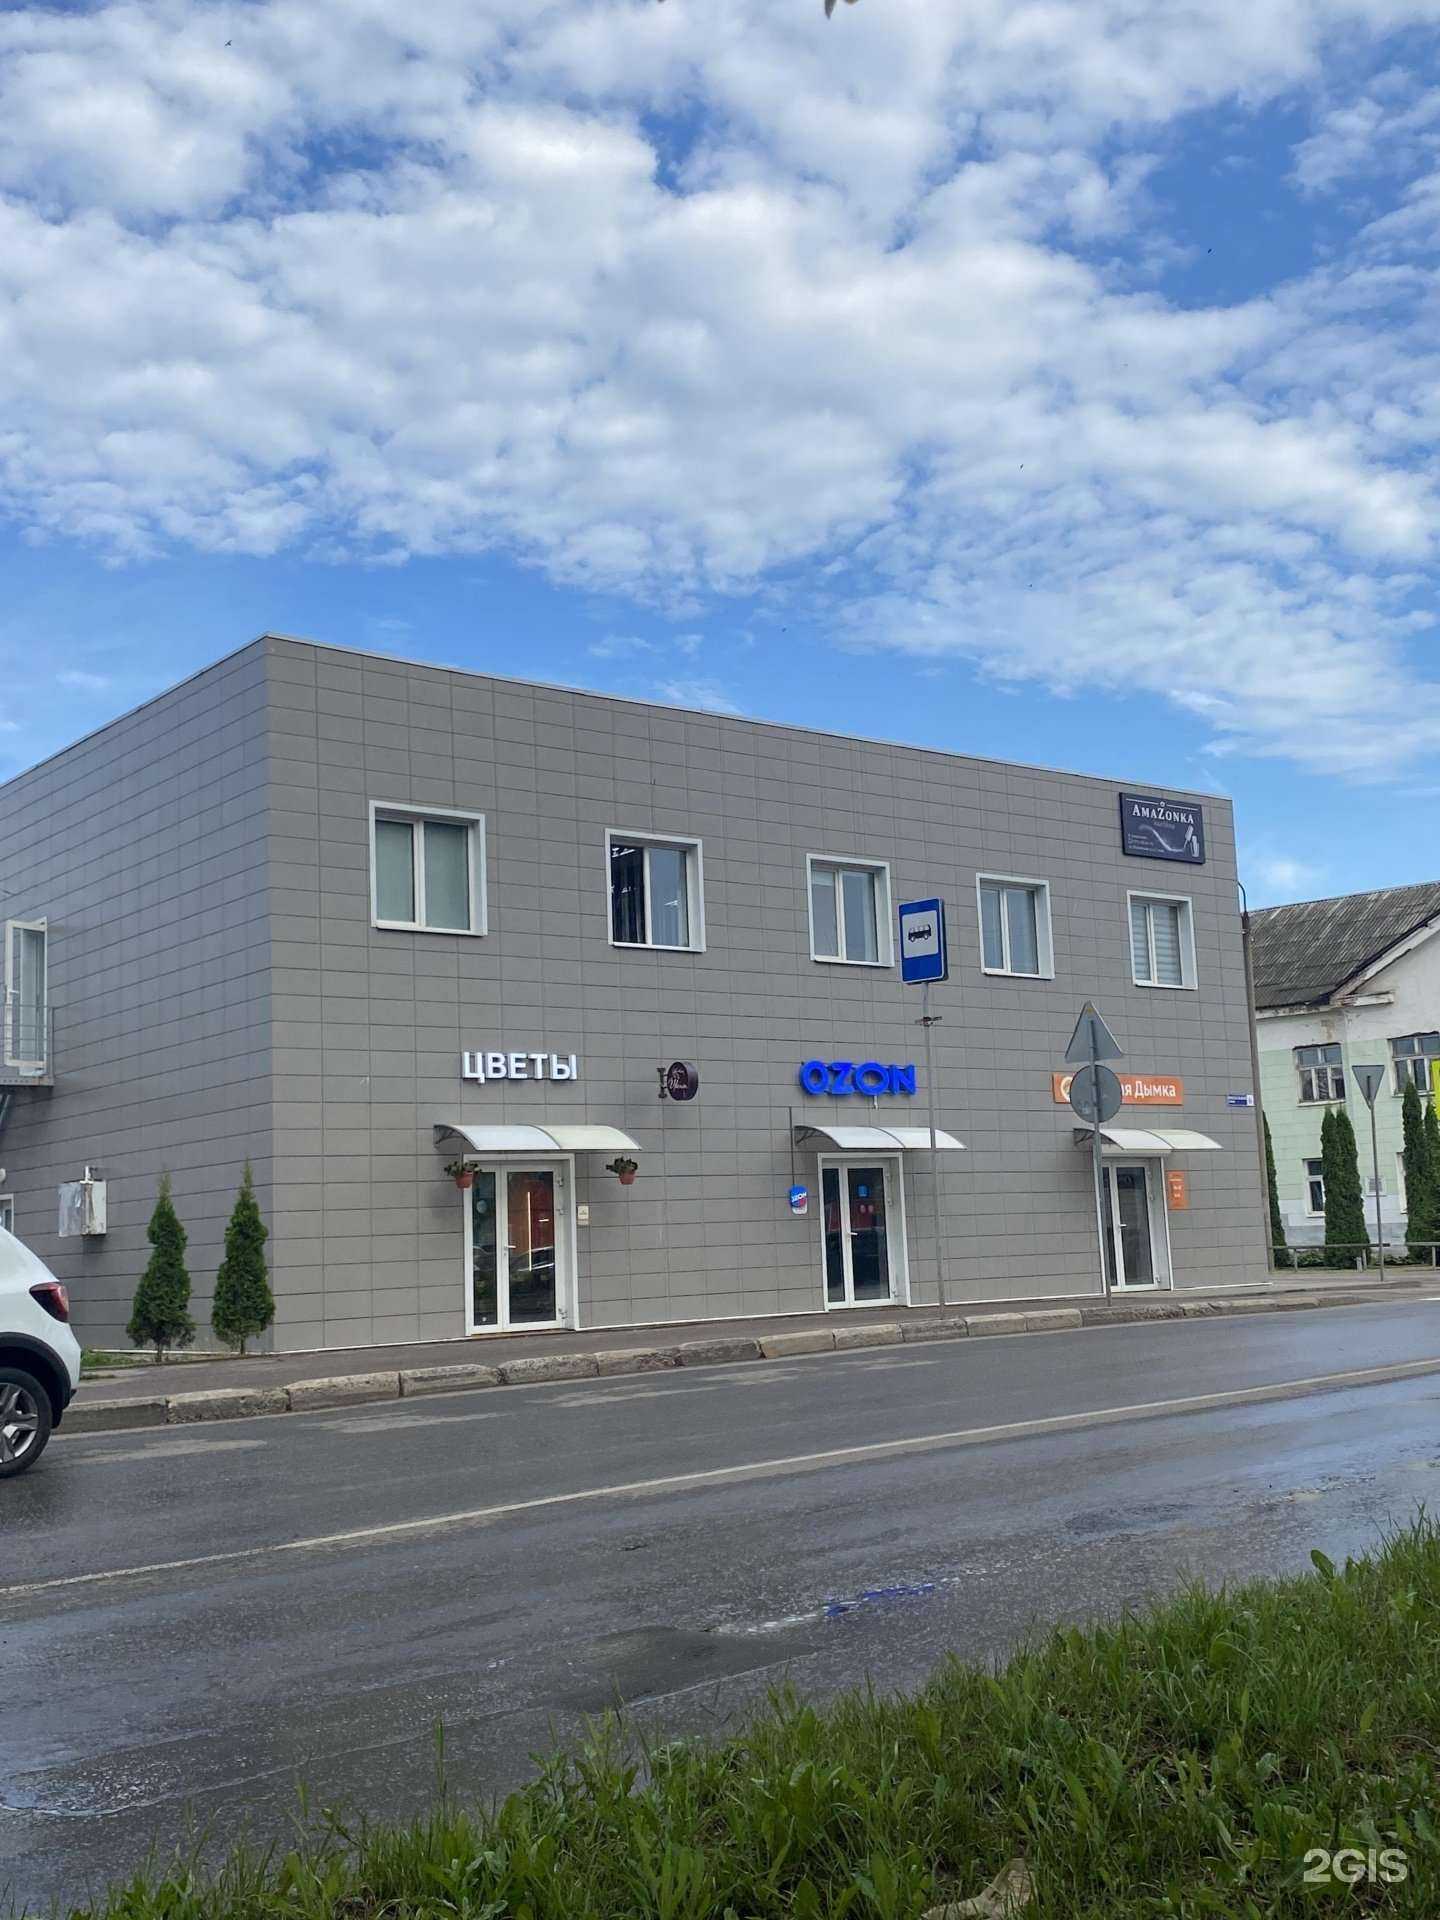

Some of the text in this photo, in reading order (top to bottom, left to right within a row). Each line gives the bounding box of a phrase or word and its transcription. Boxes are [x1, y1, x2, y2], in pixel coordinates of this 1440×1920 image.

[463, 1051, 577, 1084] ЦВЕТЫ
[801, 1060, 916, 1096] OZON
[1134, 1081, 1177, 1099] Дымка
